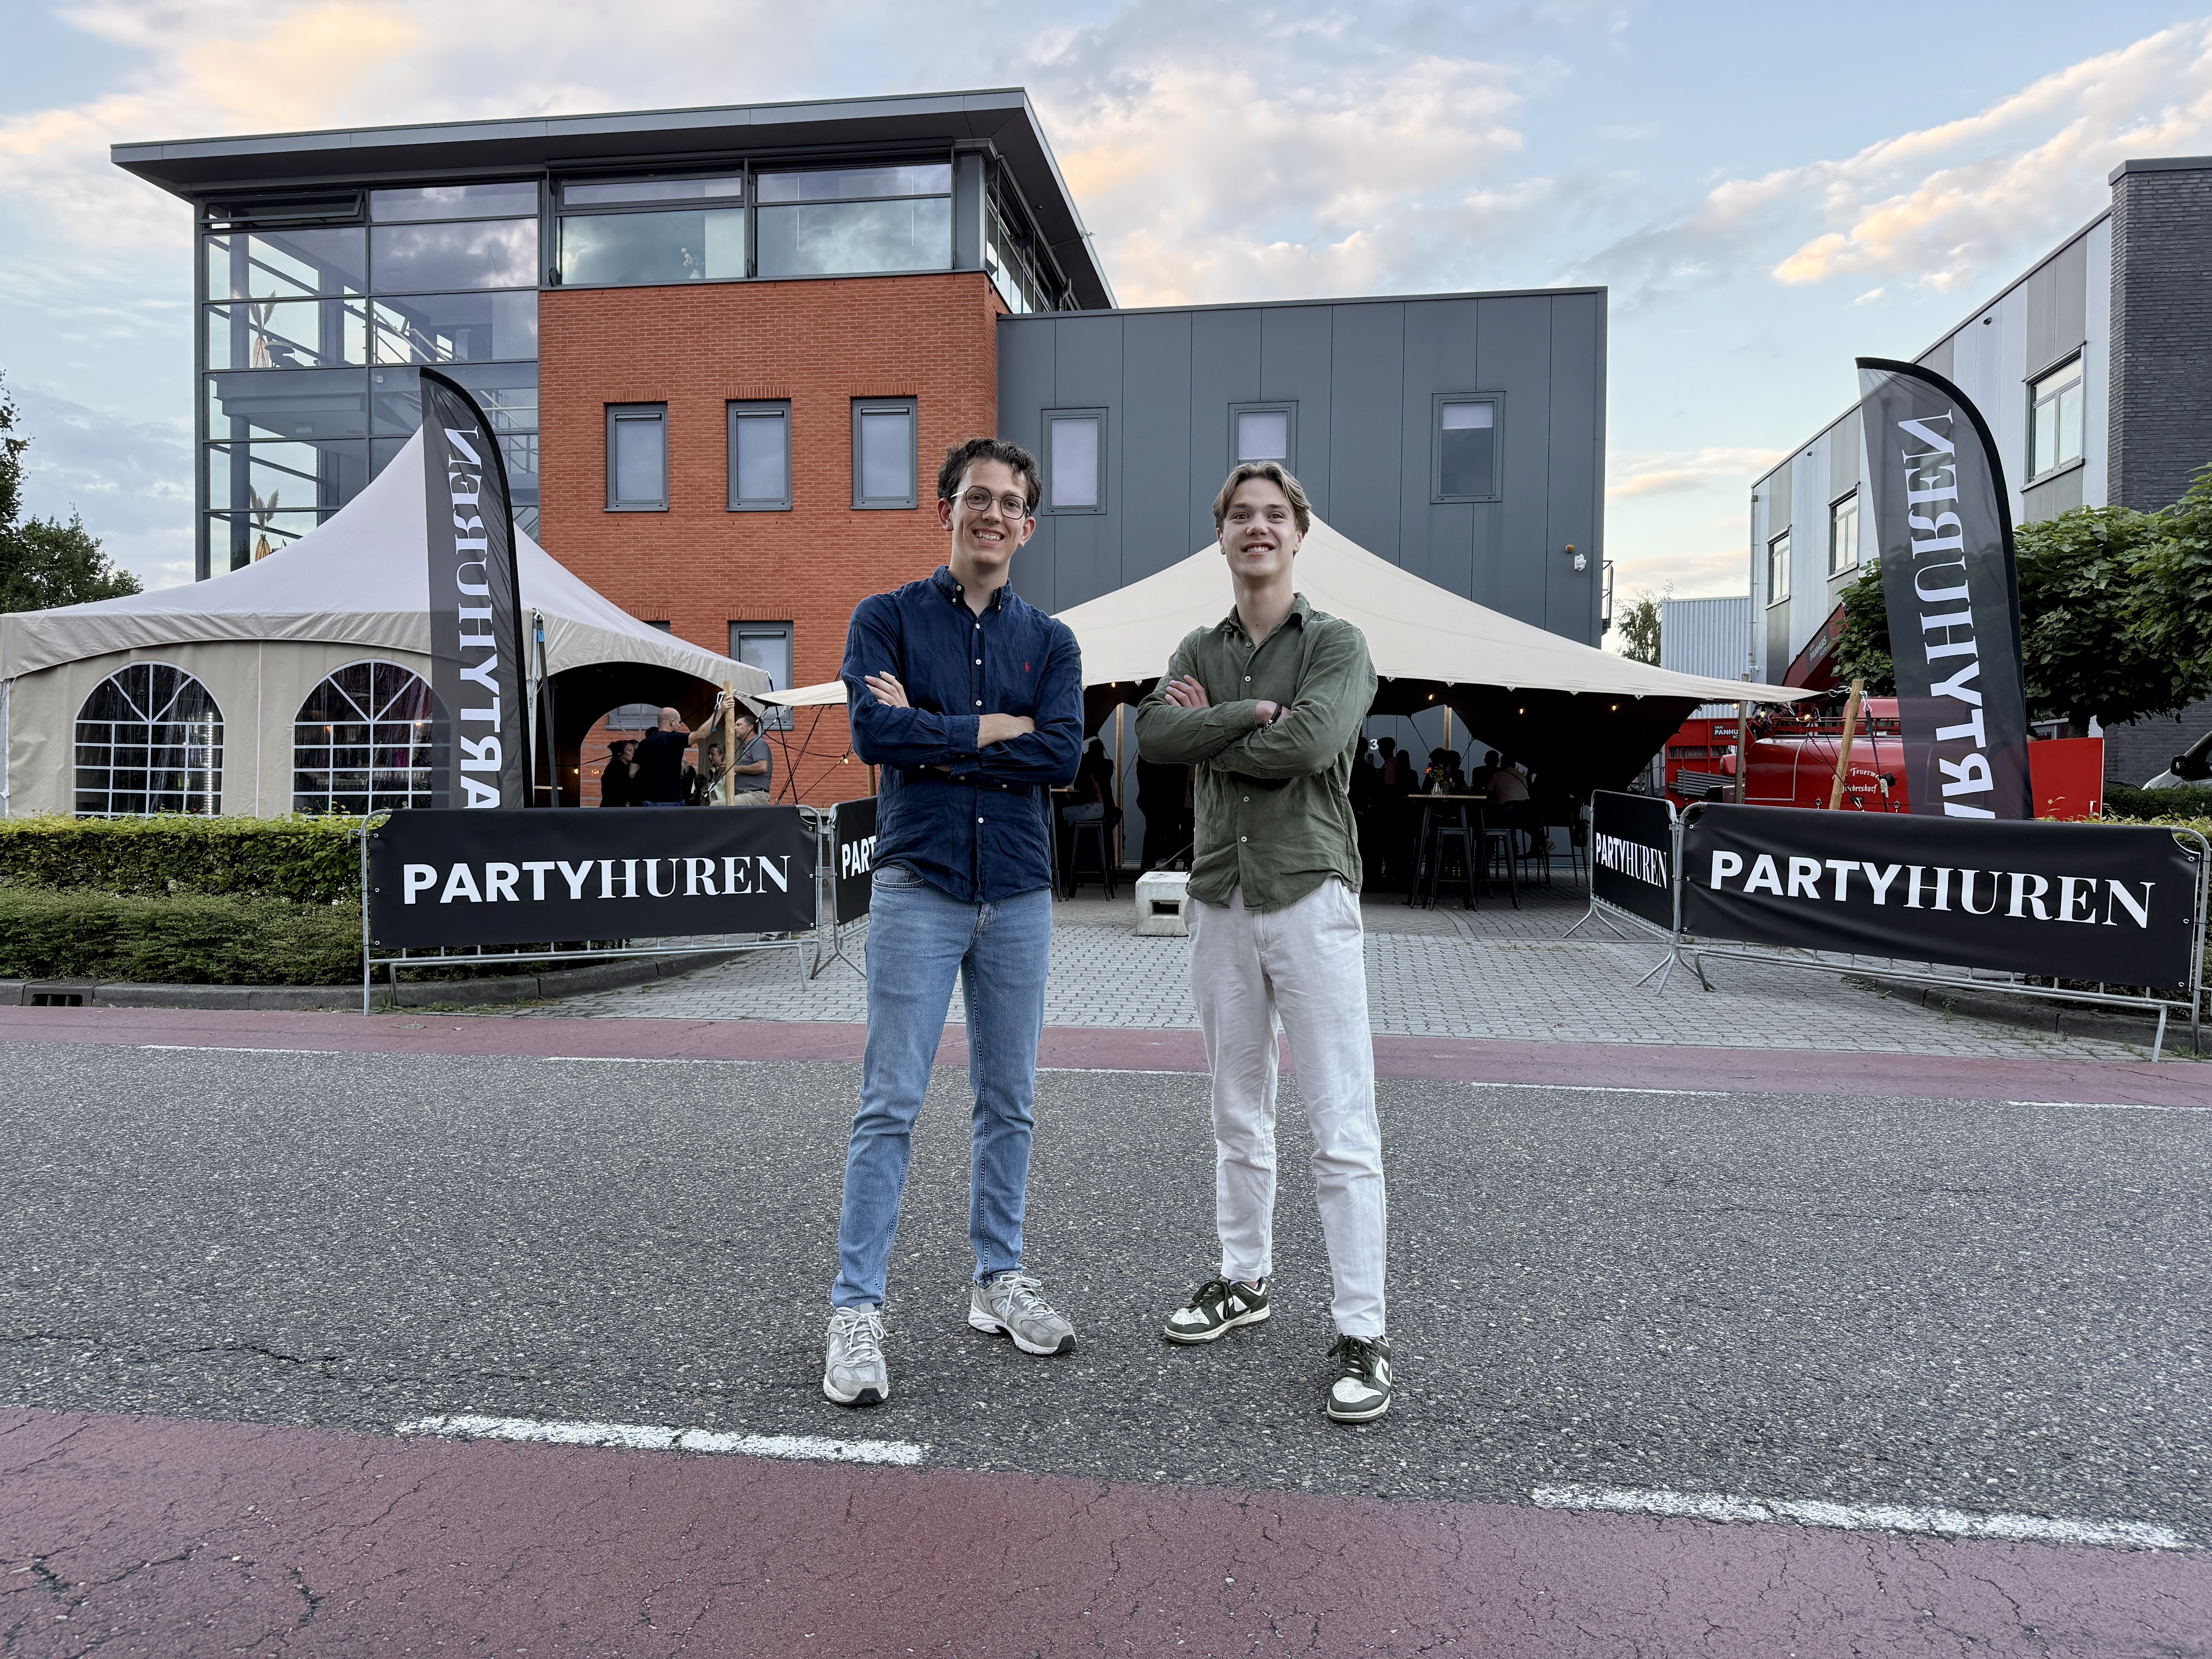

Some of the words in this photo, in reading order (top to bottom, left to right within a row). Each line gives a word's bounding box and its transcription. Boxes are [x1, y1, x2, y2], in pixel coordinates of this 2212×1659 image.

[1369, 738, 1379, 750] 3
[1850, 767, 1881, 781] Feuerwe
[404, 855, 791, 904] PARTYHUREN
[842, 835, 876, 879] PART
[1596, 832, 1667, 889] PARTYHUREN
[1711, 850, 2156, 928] PARTYHUREN
